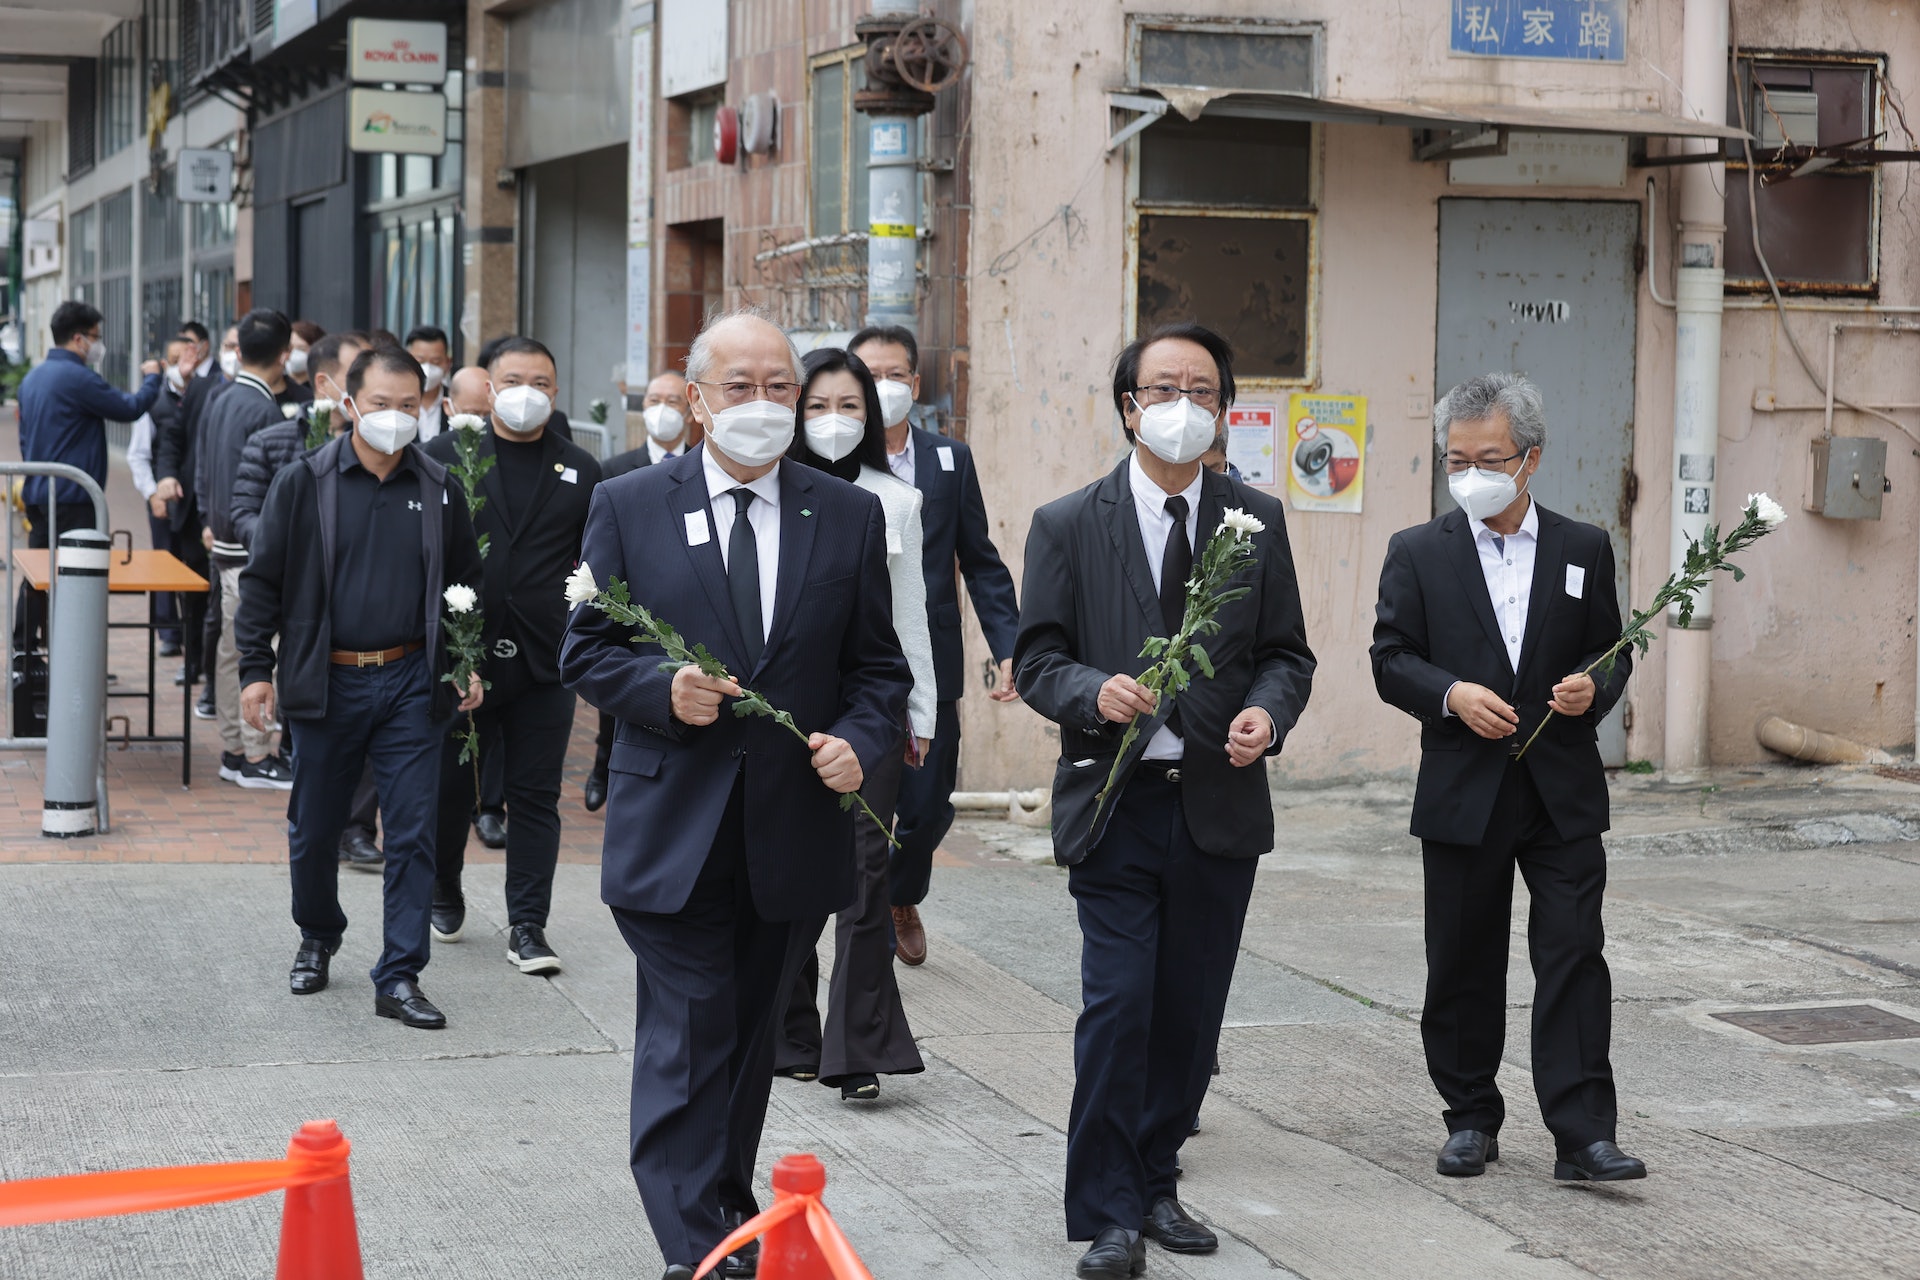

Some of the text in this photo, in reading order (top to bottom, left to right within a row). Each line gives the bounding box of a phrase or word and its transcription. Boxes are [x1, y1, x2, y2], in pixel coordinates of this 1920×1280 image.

[1464, 6, 1612, 48] 私家路
[364, 50, 439, 63] ROYAL CANIN
